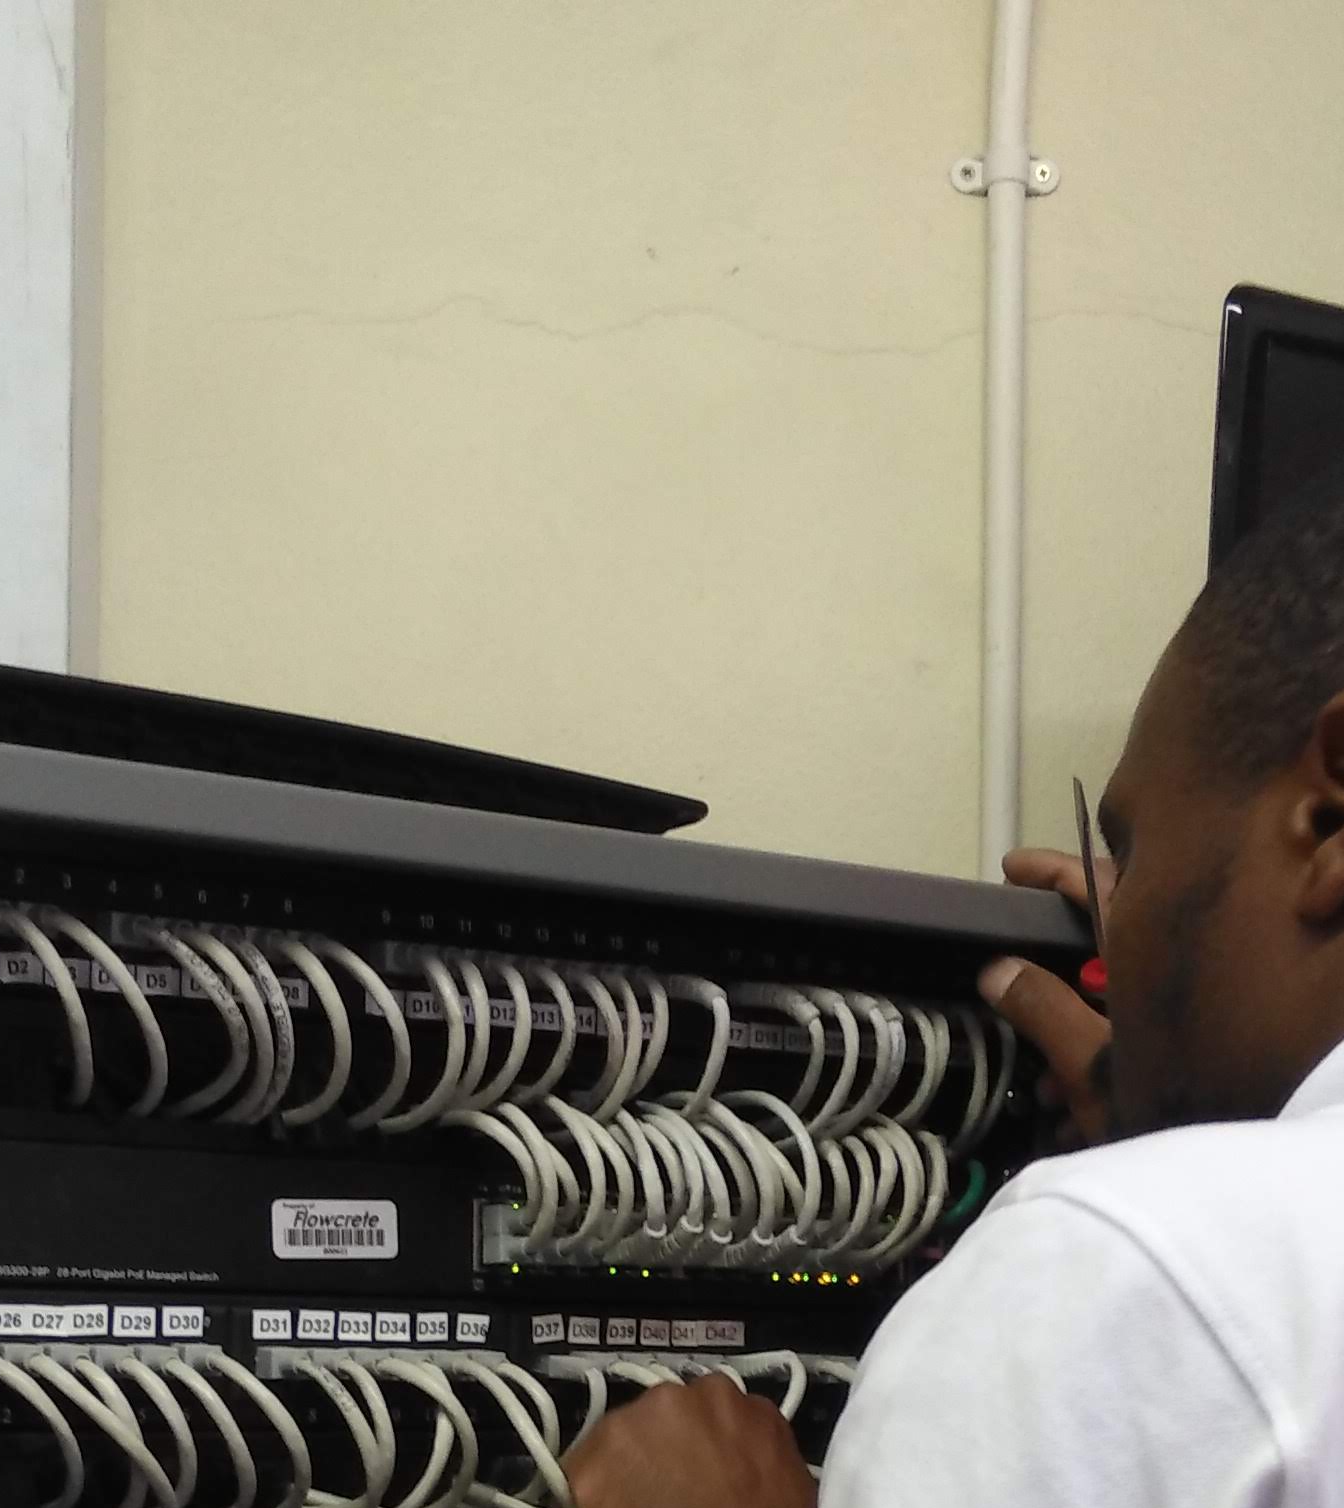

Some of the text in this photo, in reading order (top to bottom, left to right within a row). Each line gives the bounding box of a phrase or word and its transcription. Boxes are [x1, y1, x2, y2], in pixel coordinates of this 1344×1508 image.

[6, 960, 29, 976] D2
[145, 973, 168, 989] D5
[292, 1208, 380, 1228] Flowcrete
[31, 1312, 64, 1329] D27
[72, 1310, 105, 1329] D28
[120, 1314, 152, 1331] D29
[169, 1314, 200, 1330] D30
[260, 1317, 288, 1333] D31
[302, 1318, 331, 1334] D32
[340, 1319, 369, 1335] D33
[379, 1319, 408, 1335] D34
[418, 1320, 446, 1335] D35
[460, 1320, 488, 1337] D36
[534, 1322, 558, 1338] D37
[572, 1322, 597, 1338] D38
[609, 1325, 635, 1339] D39
[673, 1326, 695, 1340] D41
[706, 1326, 737, 1341] D42
